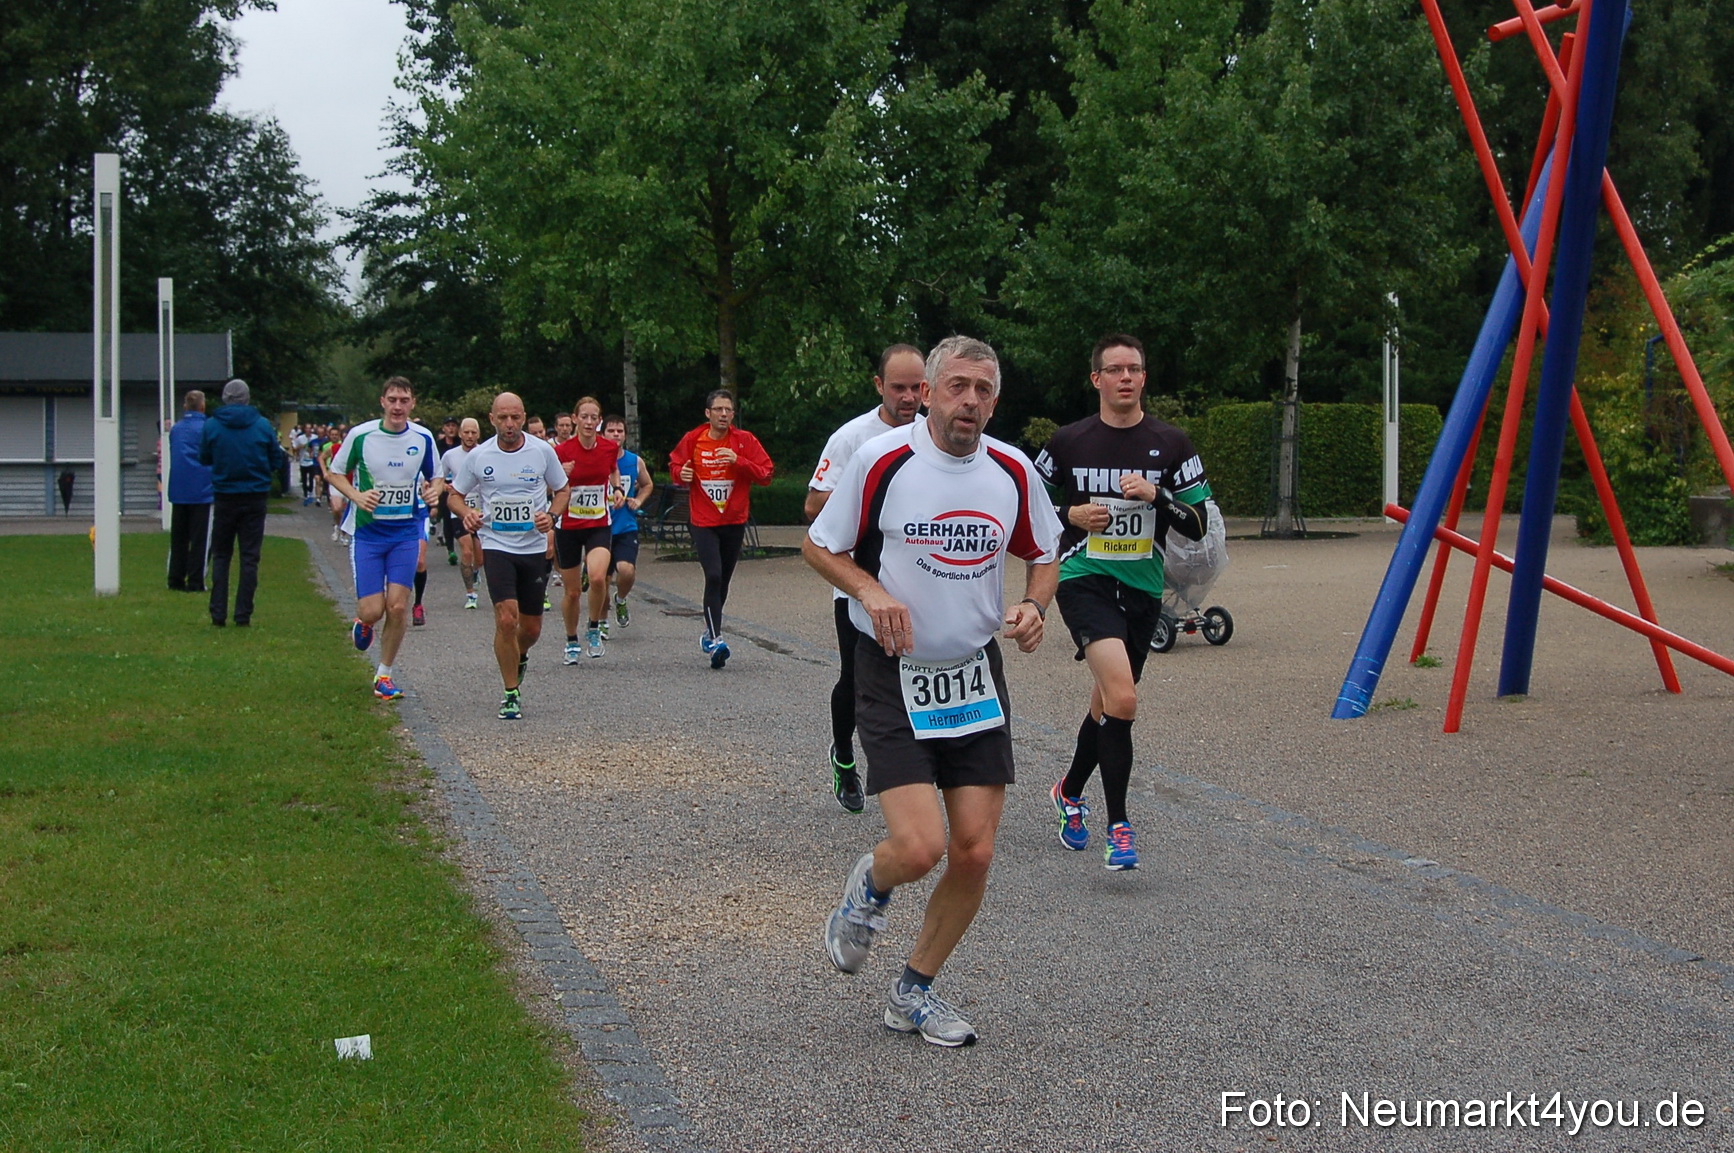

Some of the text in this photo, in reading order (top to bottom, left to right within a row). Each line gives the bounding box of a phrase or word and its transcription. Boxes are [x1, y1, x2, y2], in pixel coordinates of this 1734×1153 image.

[814, 458, 831, 482] 2
[1072, 467, 1162, 493] THUE
[378, 489, 411, 504] 2799
[576, 494, 598, 506] 473
[708, 488, 728, 501] 301
[494, 506, 530, 521] 2013
[903, 523, 998, 537] GERHART &
[1101, 513, 1143, 536] 250
[905, 537, 944, 546] Autohaus
[943, 538, 998, 552] JÄNIG
[1103, 541, 1137, 552] Rickard
[916, 557, 934, 572] Das
[931, 568, 970, 581] sportliche
[901, 663, 933, 674] PARTL
[911, 665, 986, 707] 3014
[928, 708, 982, 727] Hermann
